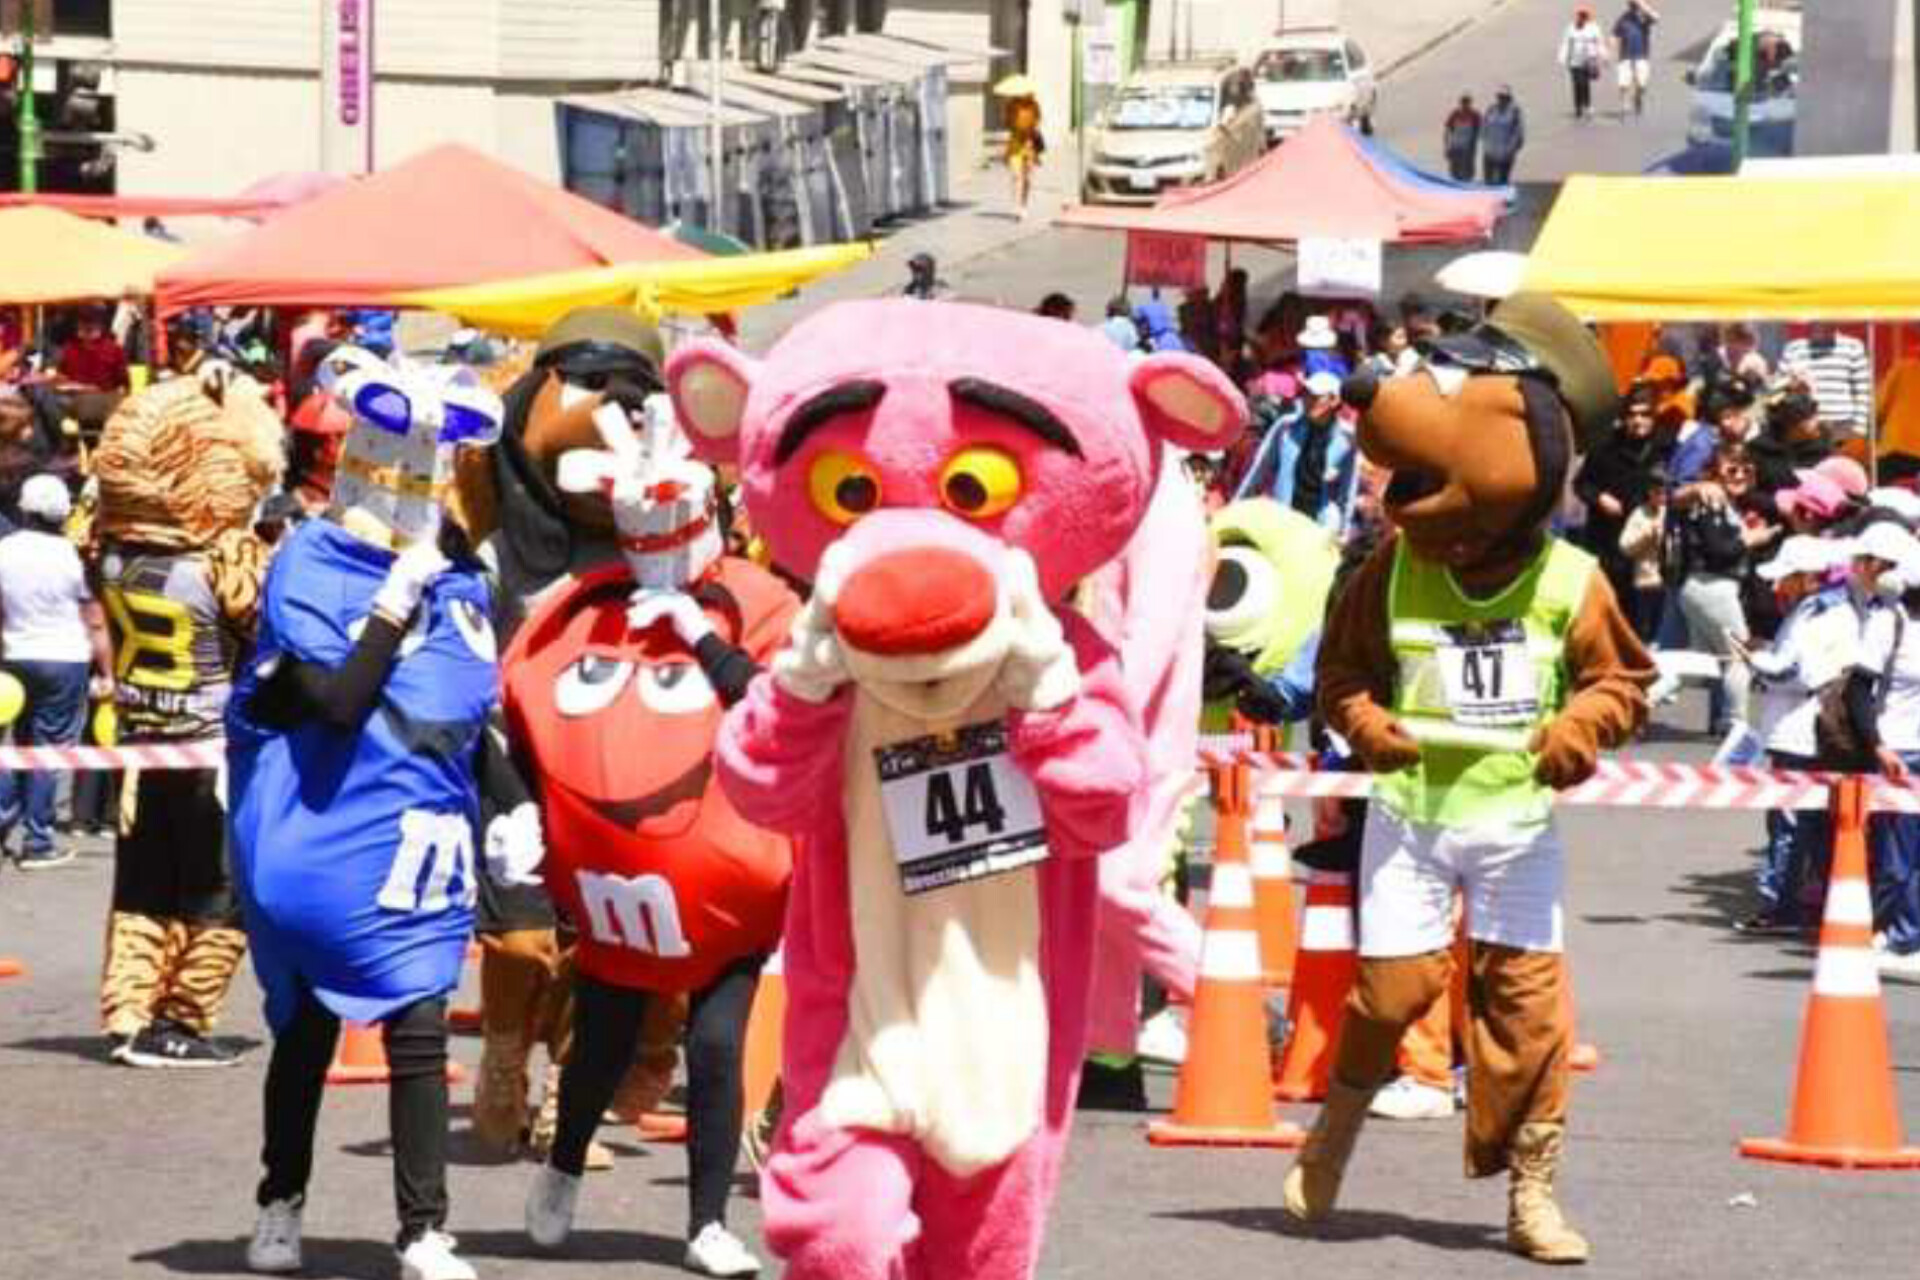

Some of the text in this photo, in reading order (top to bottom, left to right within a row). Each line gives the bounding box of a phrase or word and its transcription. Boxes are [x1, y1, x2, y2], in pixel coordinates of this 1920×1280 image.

[1462, 648, 1503, 699] 47
[926, 762, 1005, 843] 44
[575, 868, 692, 958] m
